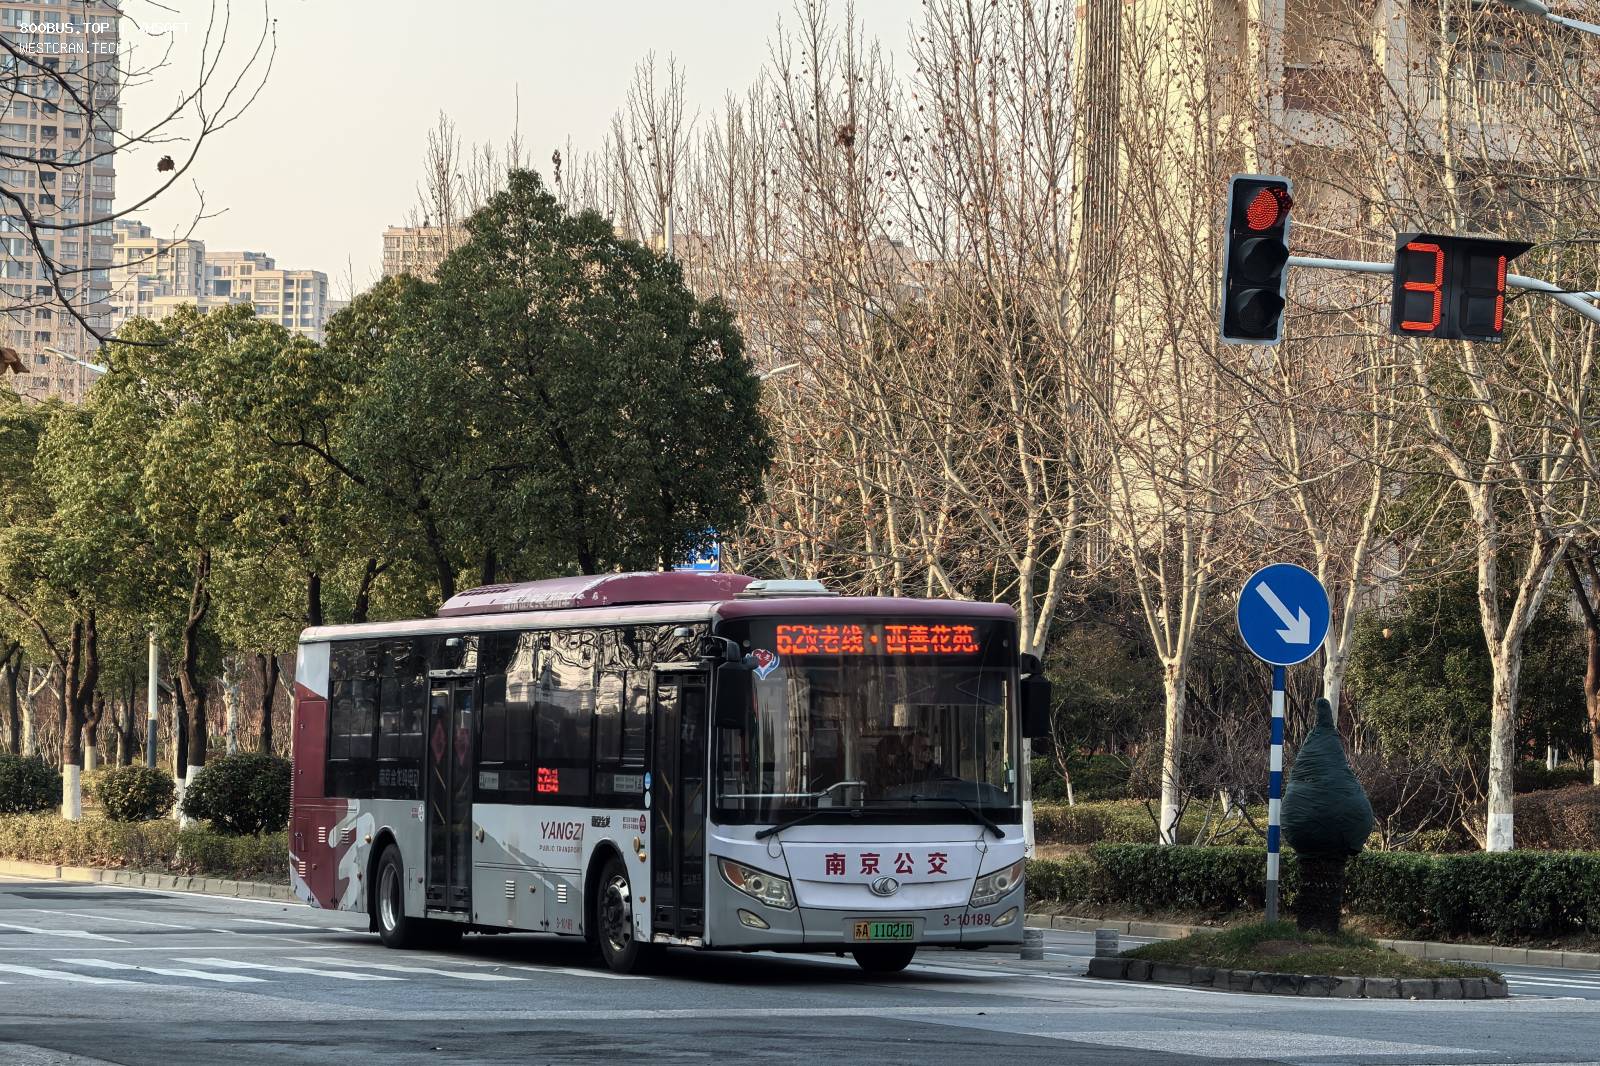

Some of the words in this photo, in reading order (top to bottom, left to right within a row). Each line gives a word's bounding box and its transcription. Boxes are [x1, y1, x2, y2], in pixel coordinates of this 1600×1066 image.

[1400, 242, 1507, 332] 31
[540, 821, 585, 841] YANGZI
[824, 852, 948, 876] 南京公交
[943, 913, 991, 927] 3-10189
